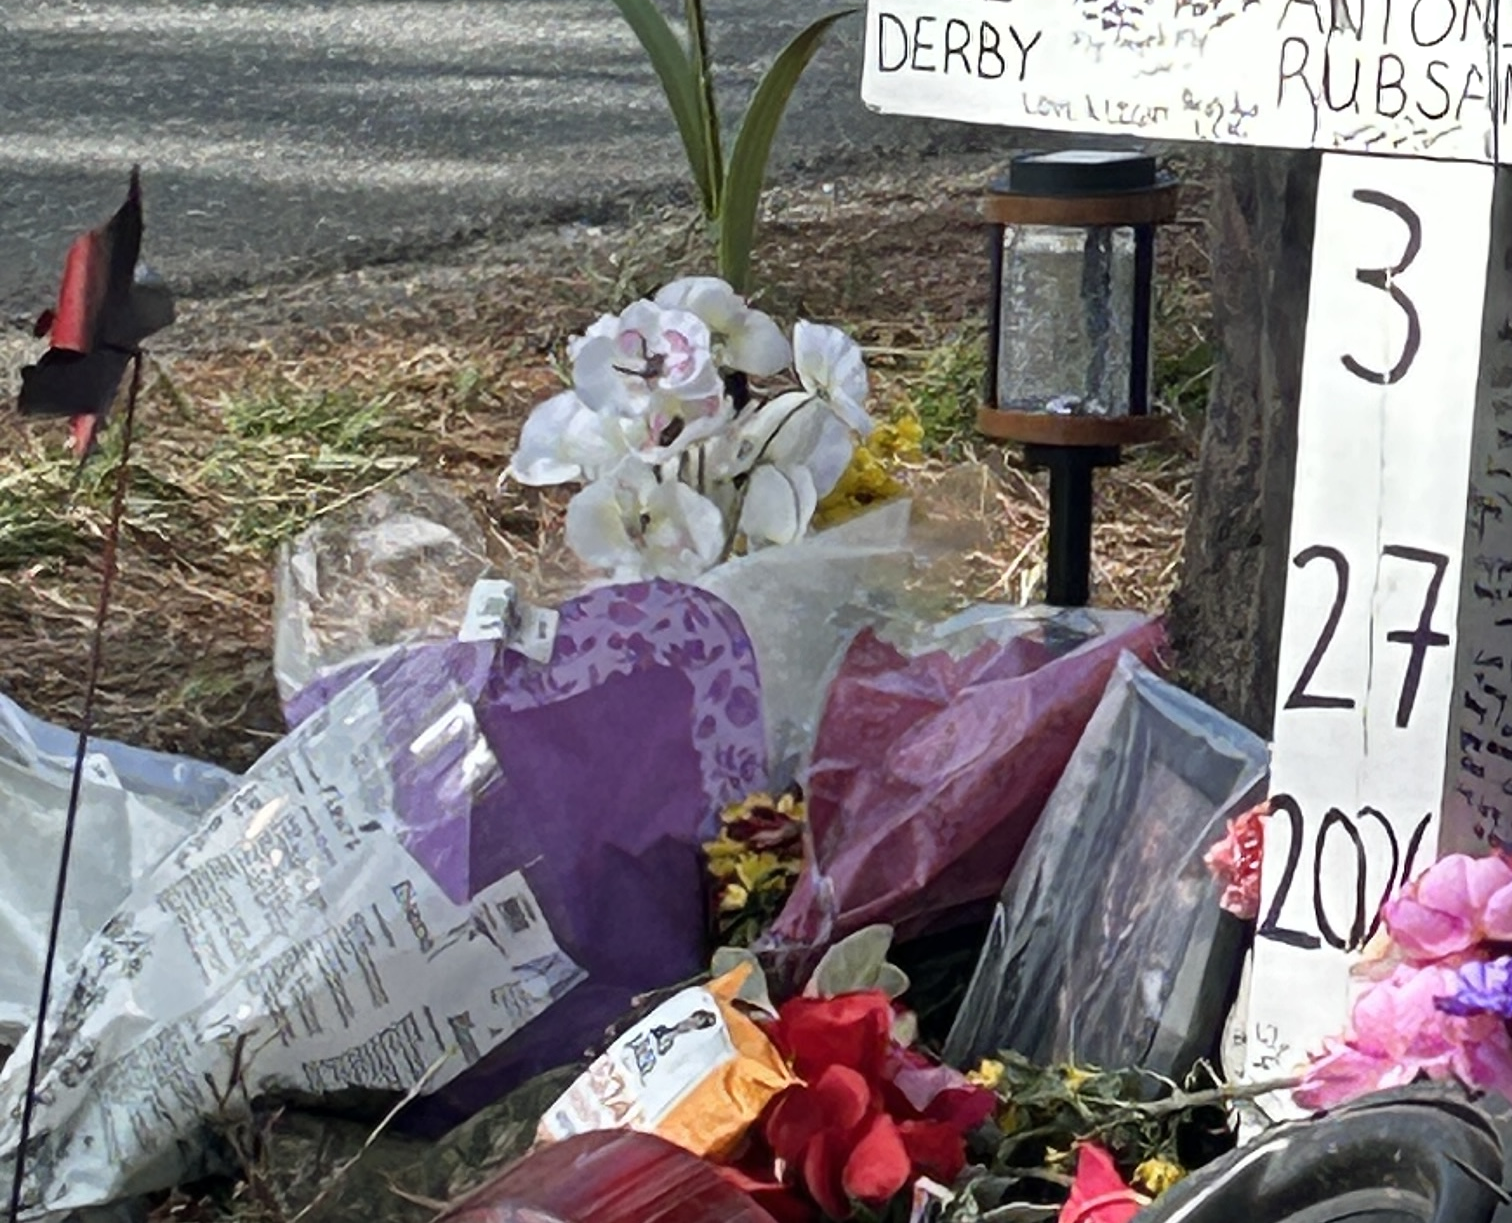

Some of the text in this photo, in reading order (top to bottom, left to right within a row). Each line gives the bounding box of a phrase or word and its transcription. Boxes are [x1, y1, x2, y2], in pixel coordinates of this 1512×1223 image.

[877, 11, 1043, 82] DERBY
[1341, 188, 1422, 385] 3
[1283, 543, 1450, 729] 27
